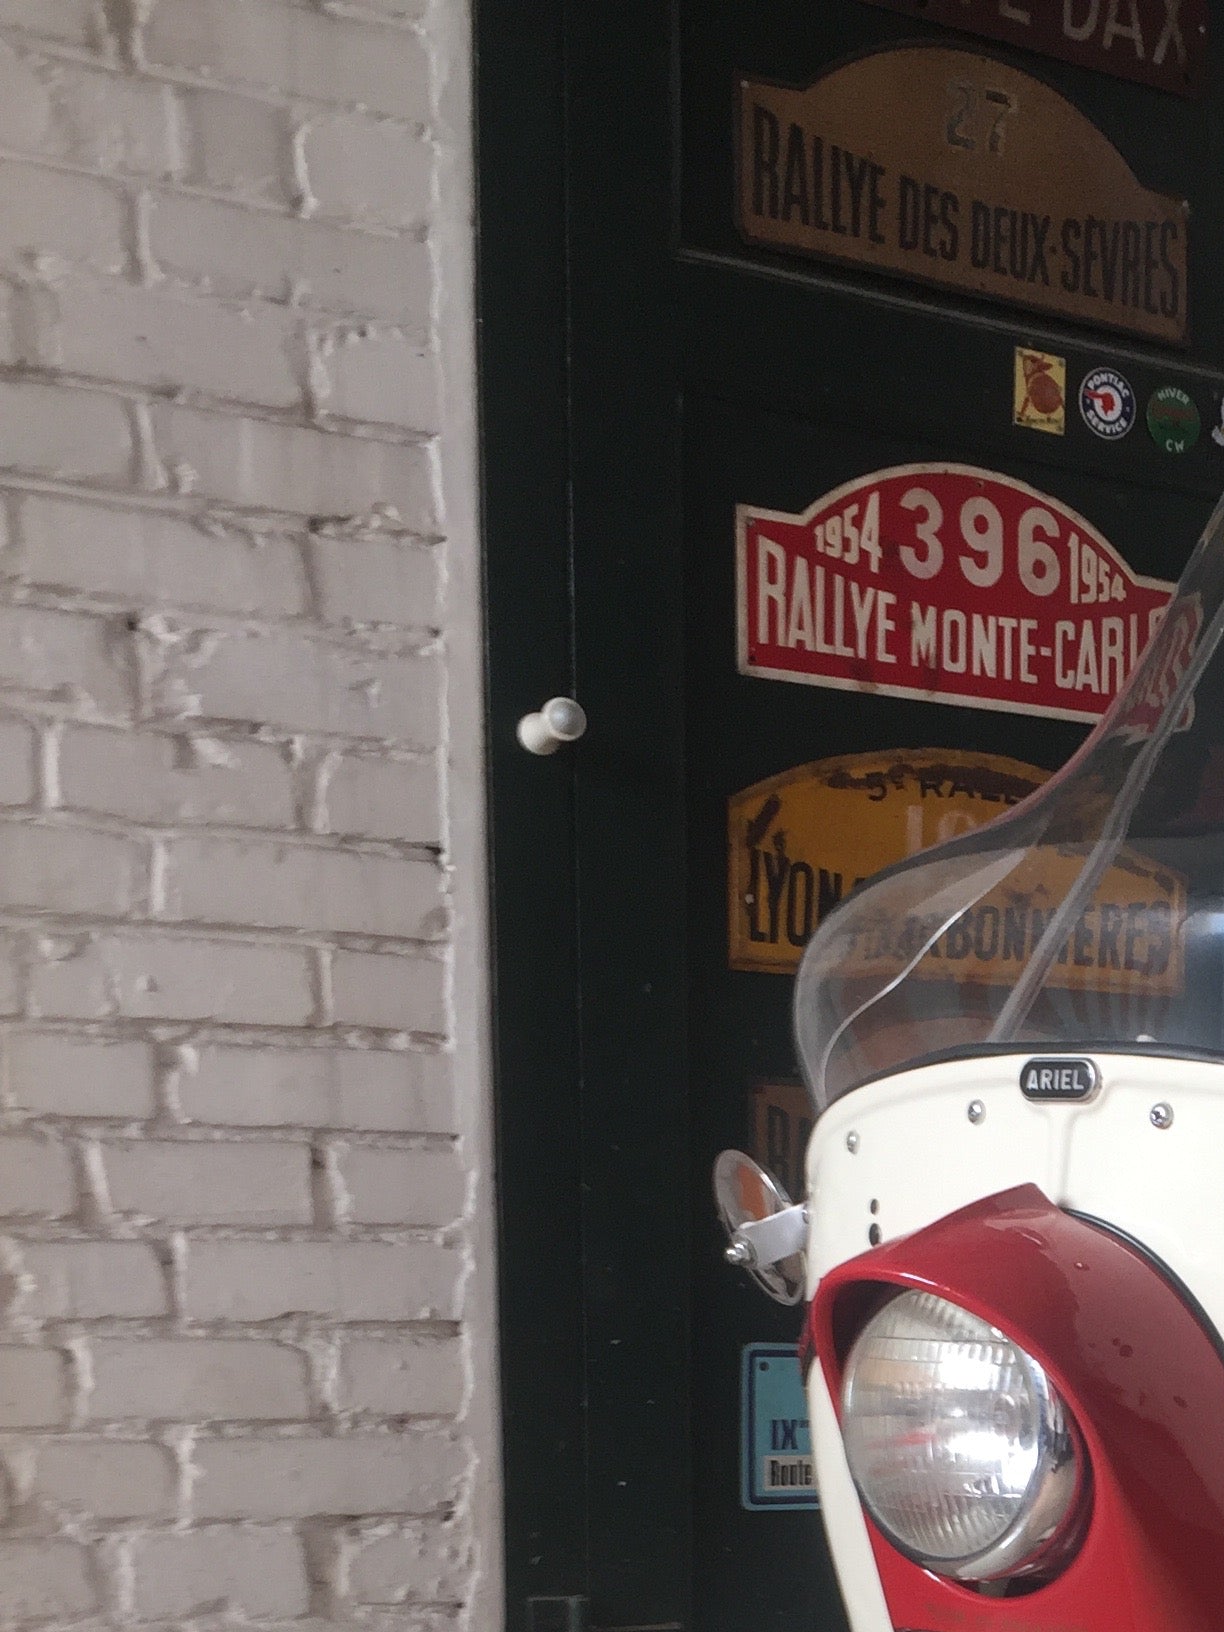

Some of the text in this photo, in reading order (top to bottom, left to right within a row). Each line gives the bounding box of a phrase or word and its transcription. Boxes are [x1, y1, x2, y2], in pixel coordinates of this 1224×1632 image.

[753, 105, 887, 243] RALLYE
[899, 173, 959, 262] DES
[1086, 372, 1131, 399] PONTIAC
[814, 486, 1128, 605] 1954 396 1954
[757, 534, 1170, 696] RALLYE MONTE-CARL
[749, 845, 843, 947] LYON
[1026, 1068, 1085, 1091] ARIEL
